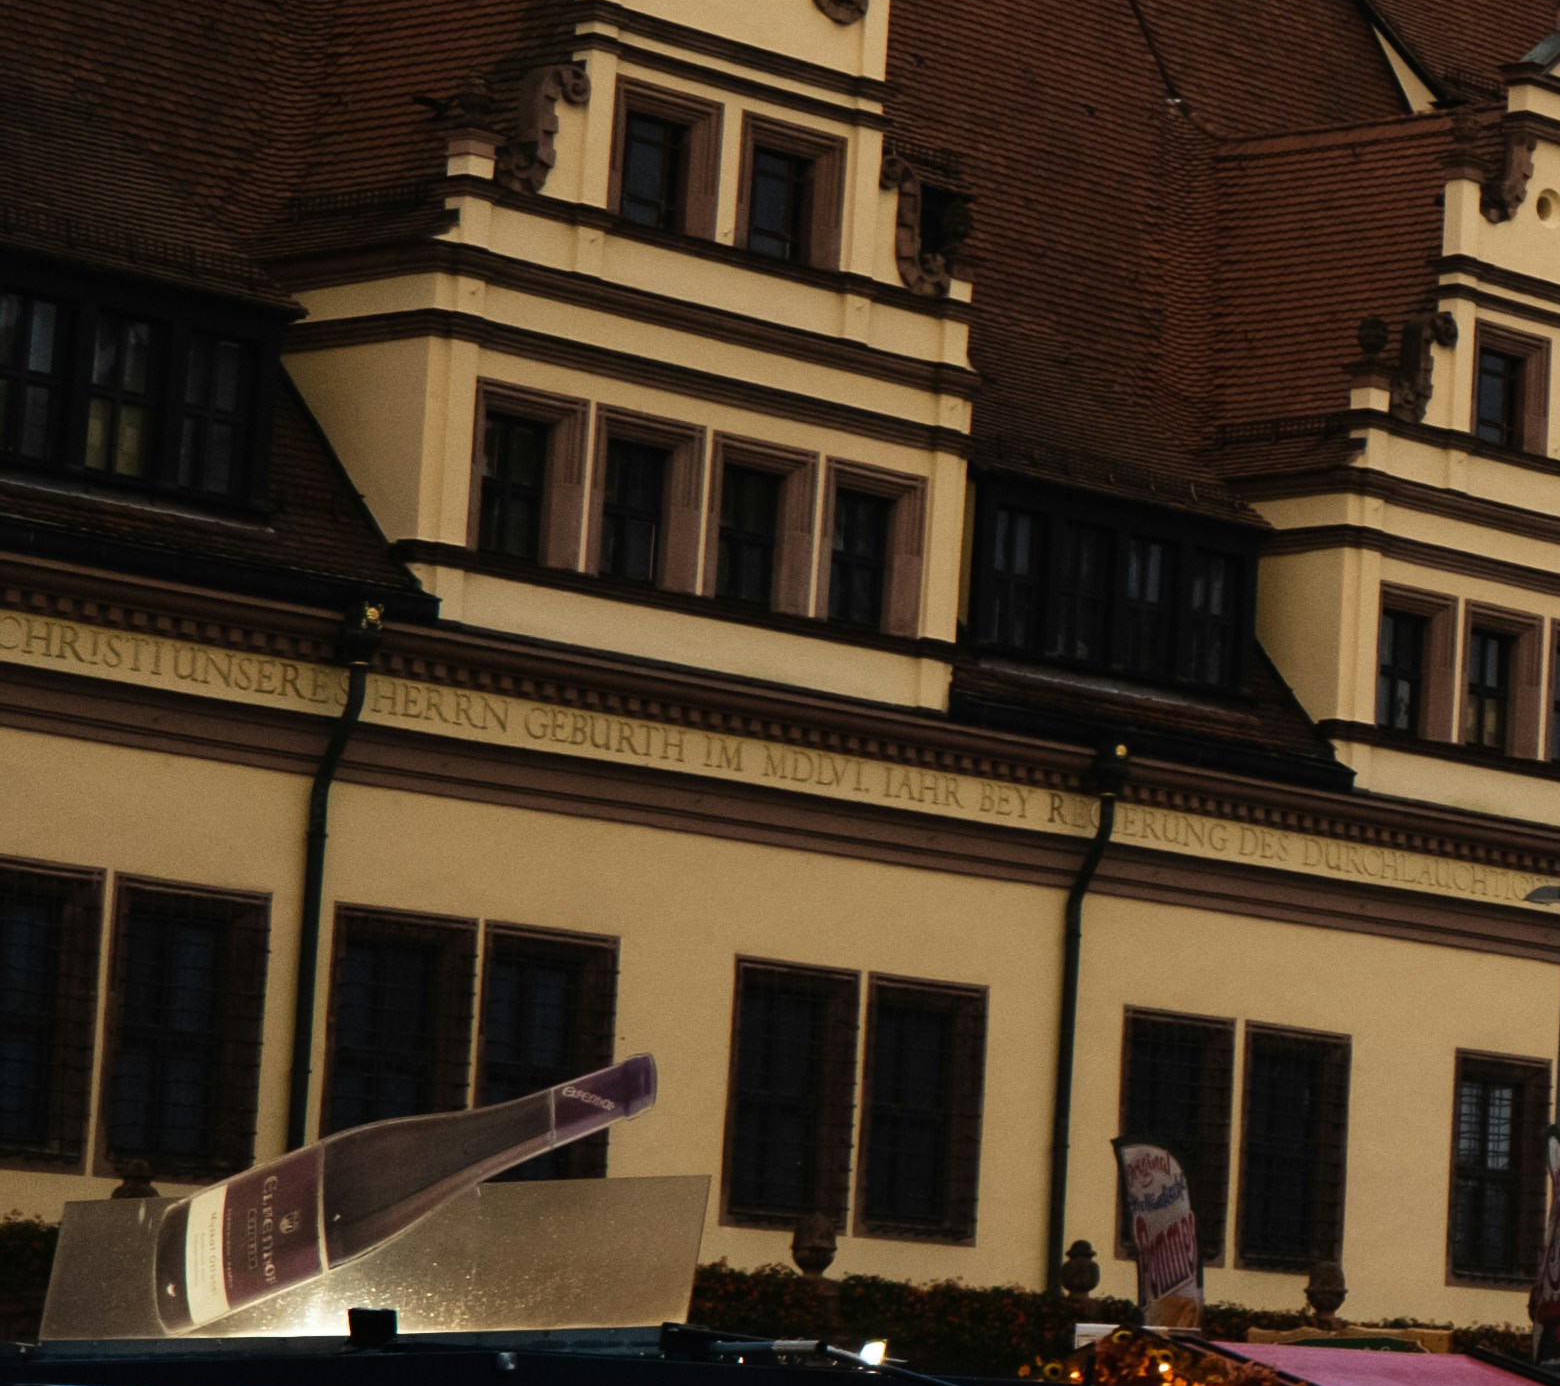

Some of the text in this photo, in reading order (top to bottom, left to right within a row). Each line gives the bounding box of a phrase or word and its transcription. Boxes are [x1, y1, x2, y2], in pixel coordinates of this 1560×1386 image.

[172, 644, 350, 707] UNSERES
[371, 677, 509, 733] HERRN
[525, 707, 685, 763] GEBURTH
[704, 736, 744, 773] IM
[883, 764, 964, 810] IAHR
[979, 782, 1040, 818] BEY
[1048, 793, 1229, 852] REGERUNG
[1240, 825, 1290, 862] DES
